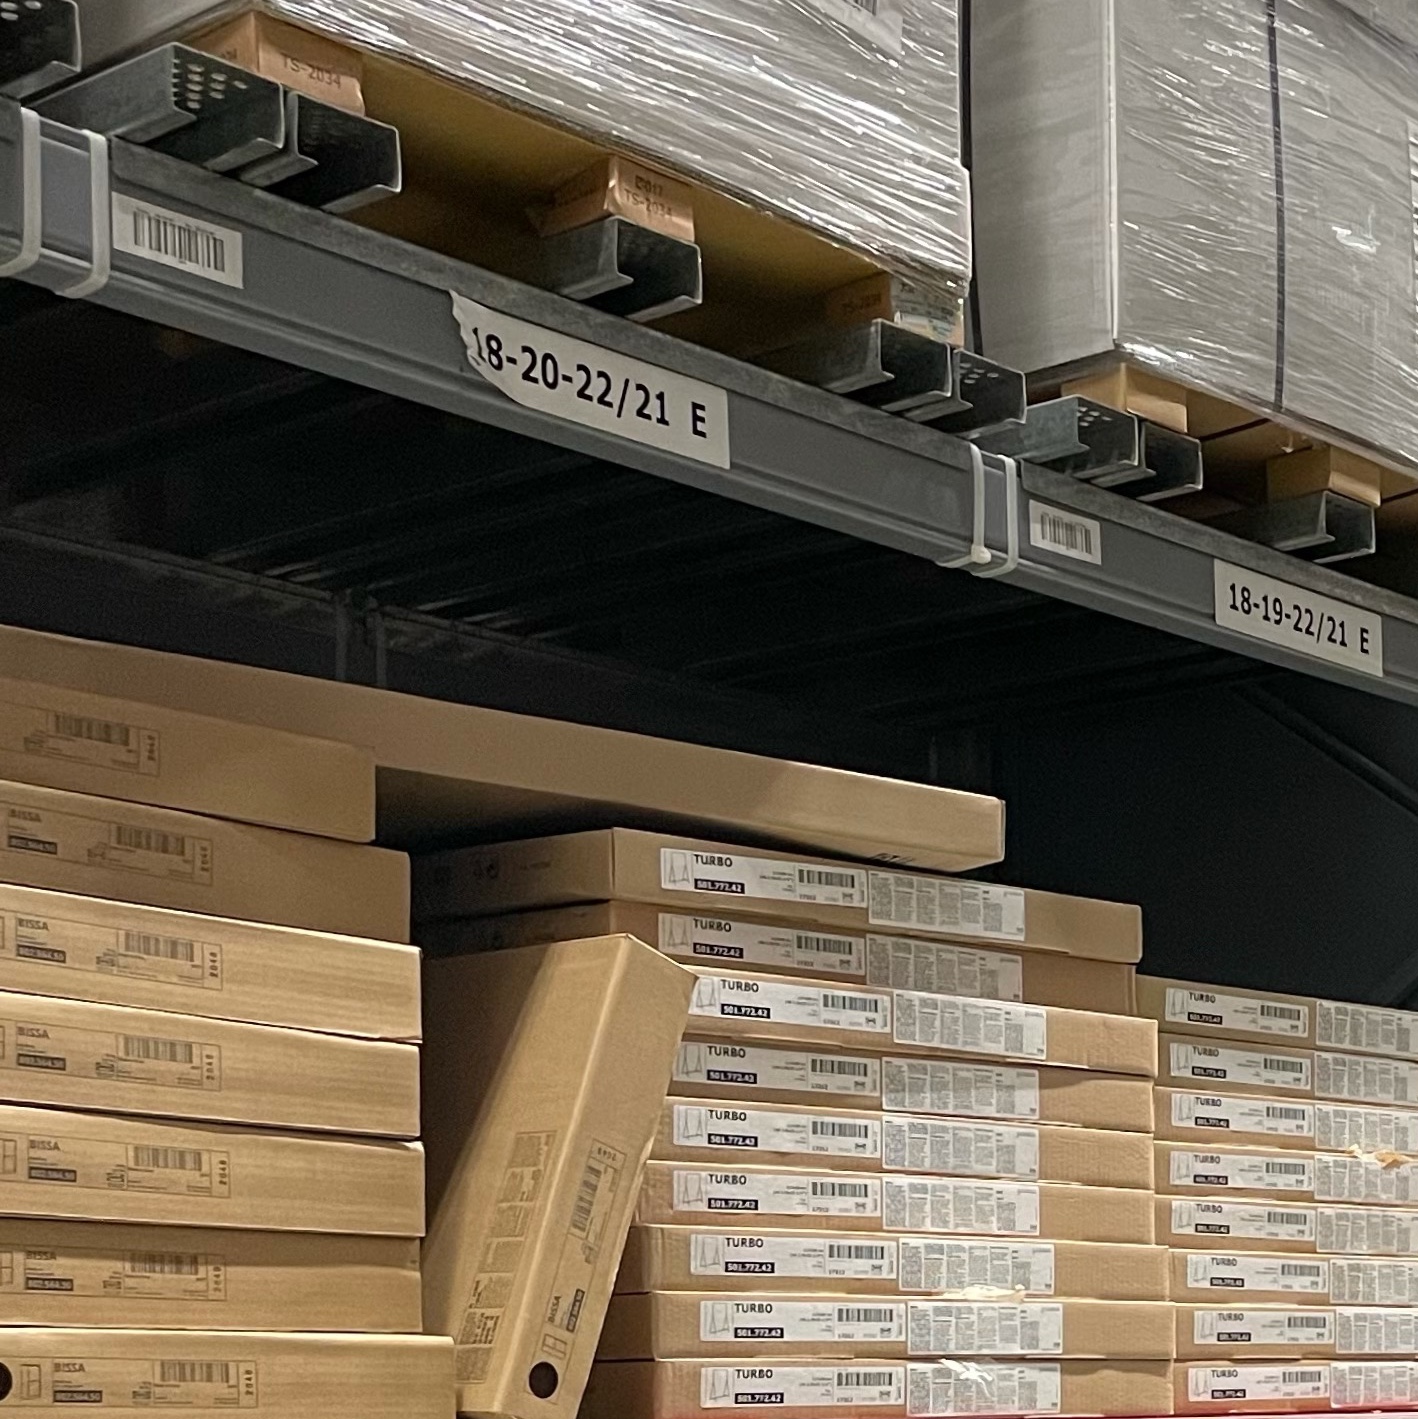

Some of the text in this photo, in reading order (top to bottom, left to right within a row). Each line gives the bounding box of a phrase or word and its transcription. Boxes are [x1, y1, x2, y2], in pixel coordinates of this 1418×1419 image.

[471, 327, 707, 439] 18-20-22/21 E
[1229, 583, 1370, 654] 18-19-22/21 E
[694, 854, 732, 867] TURBO
[17, 918, 49, 932] BISSA
[693, 918, 731, 932] TURBO
[721, 979, 759, 992] TURBO
[1189, 992, 1216, 1003] TURBO
[17, 1026, 50, 1040] BISSA
[708, 1045, 746, 1058] TURBO
[1192, 1046, 1219, 1057] TURBO
[1195, 1097, 1222, 1107] TURBO
[708, 1109, 746, 1121] TURBO
[30, 1139, 61, 1152] BISSA
[1194, 1155, 1221, 1164] TURBO
[708, 1174, 746, 1185] TURBO
[1196, 1204, 1223, 1213] TURBO
[726, 1238, 763, 1248] TURBO
[26, 1251, 57, 1262] BISSA
[1211, 1258, 1237, 1266] TURBO
[735, 1303, 772, 1313] TURBO
[1218, 1313, 1244, 1321] TURBO
[54, 1363, 86, 1374] BISSA
[735, 1369, 773, 1379] TURBO
[1211, 1370, 1238, 1378] TURBO
